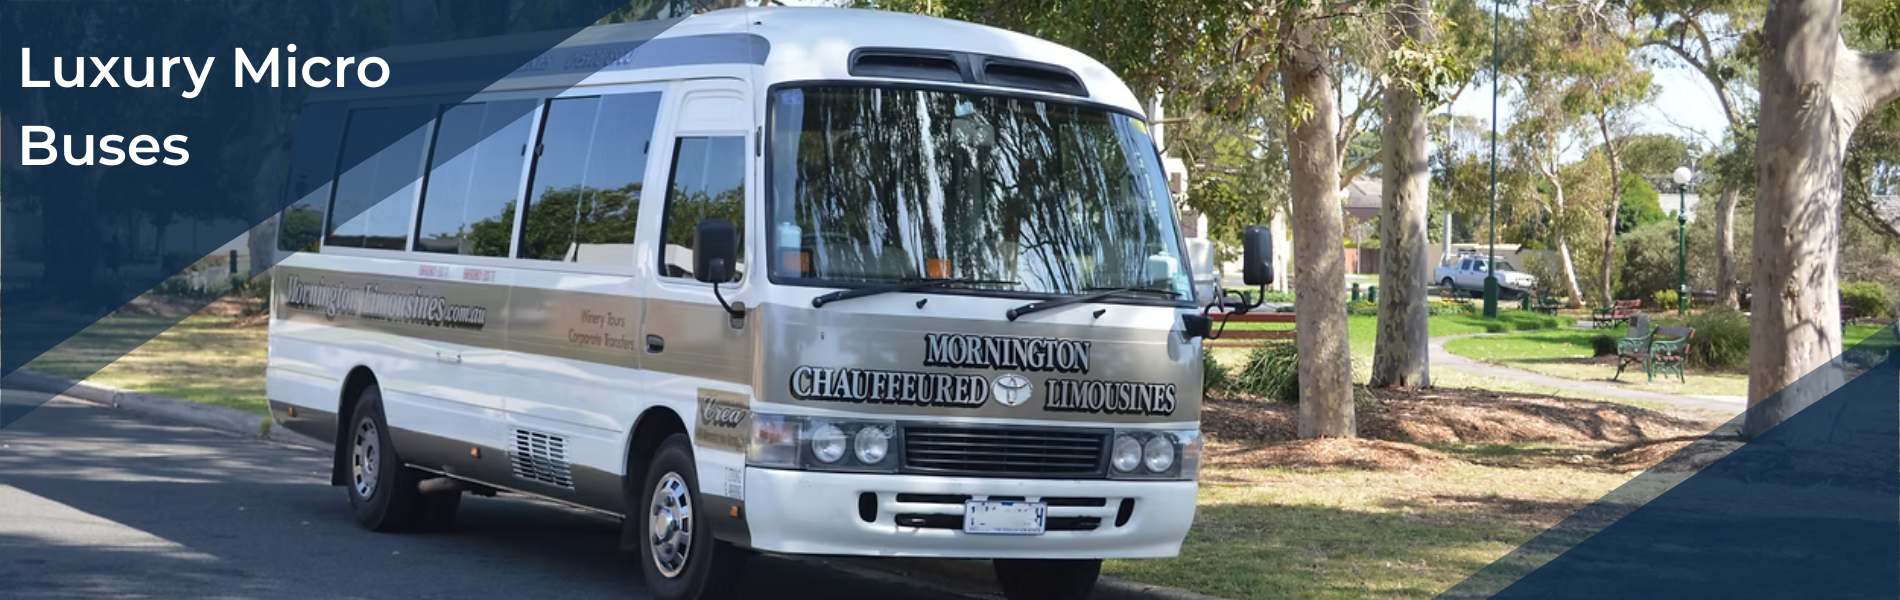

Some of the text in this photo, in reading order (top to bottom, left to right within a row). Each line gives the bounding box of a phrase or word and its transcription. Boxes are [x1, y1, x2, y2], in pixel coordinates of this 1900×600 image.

[581, 309, 625, 328] Winery Tours
[924, 333, 1091, 373] MORNINGTON
[789, 365, 1177, 416] CHAUFFEURED LIMOUSINES
